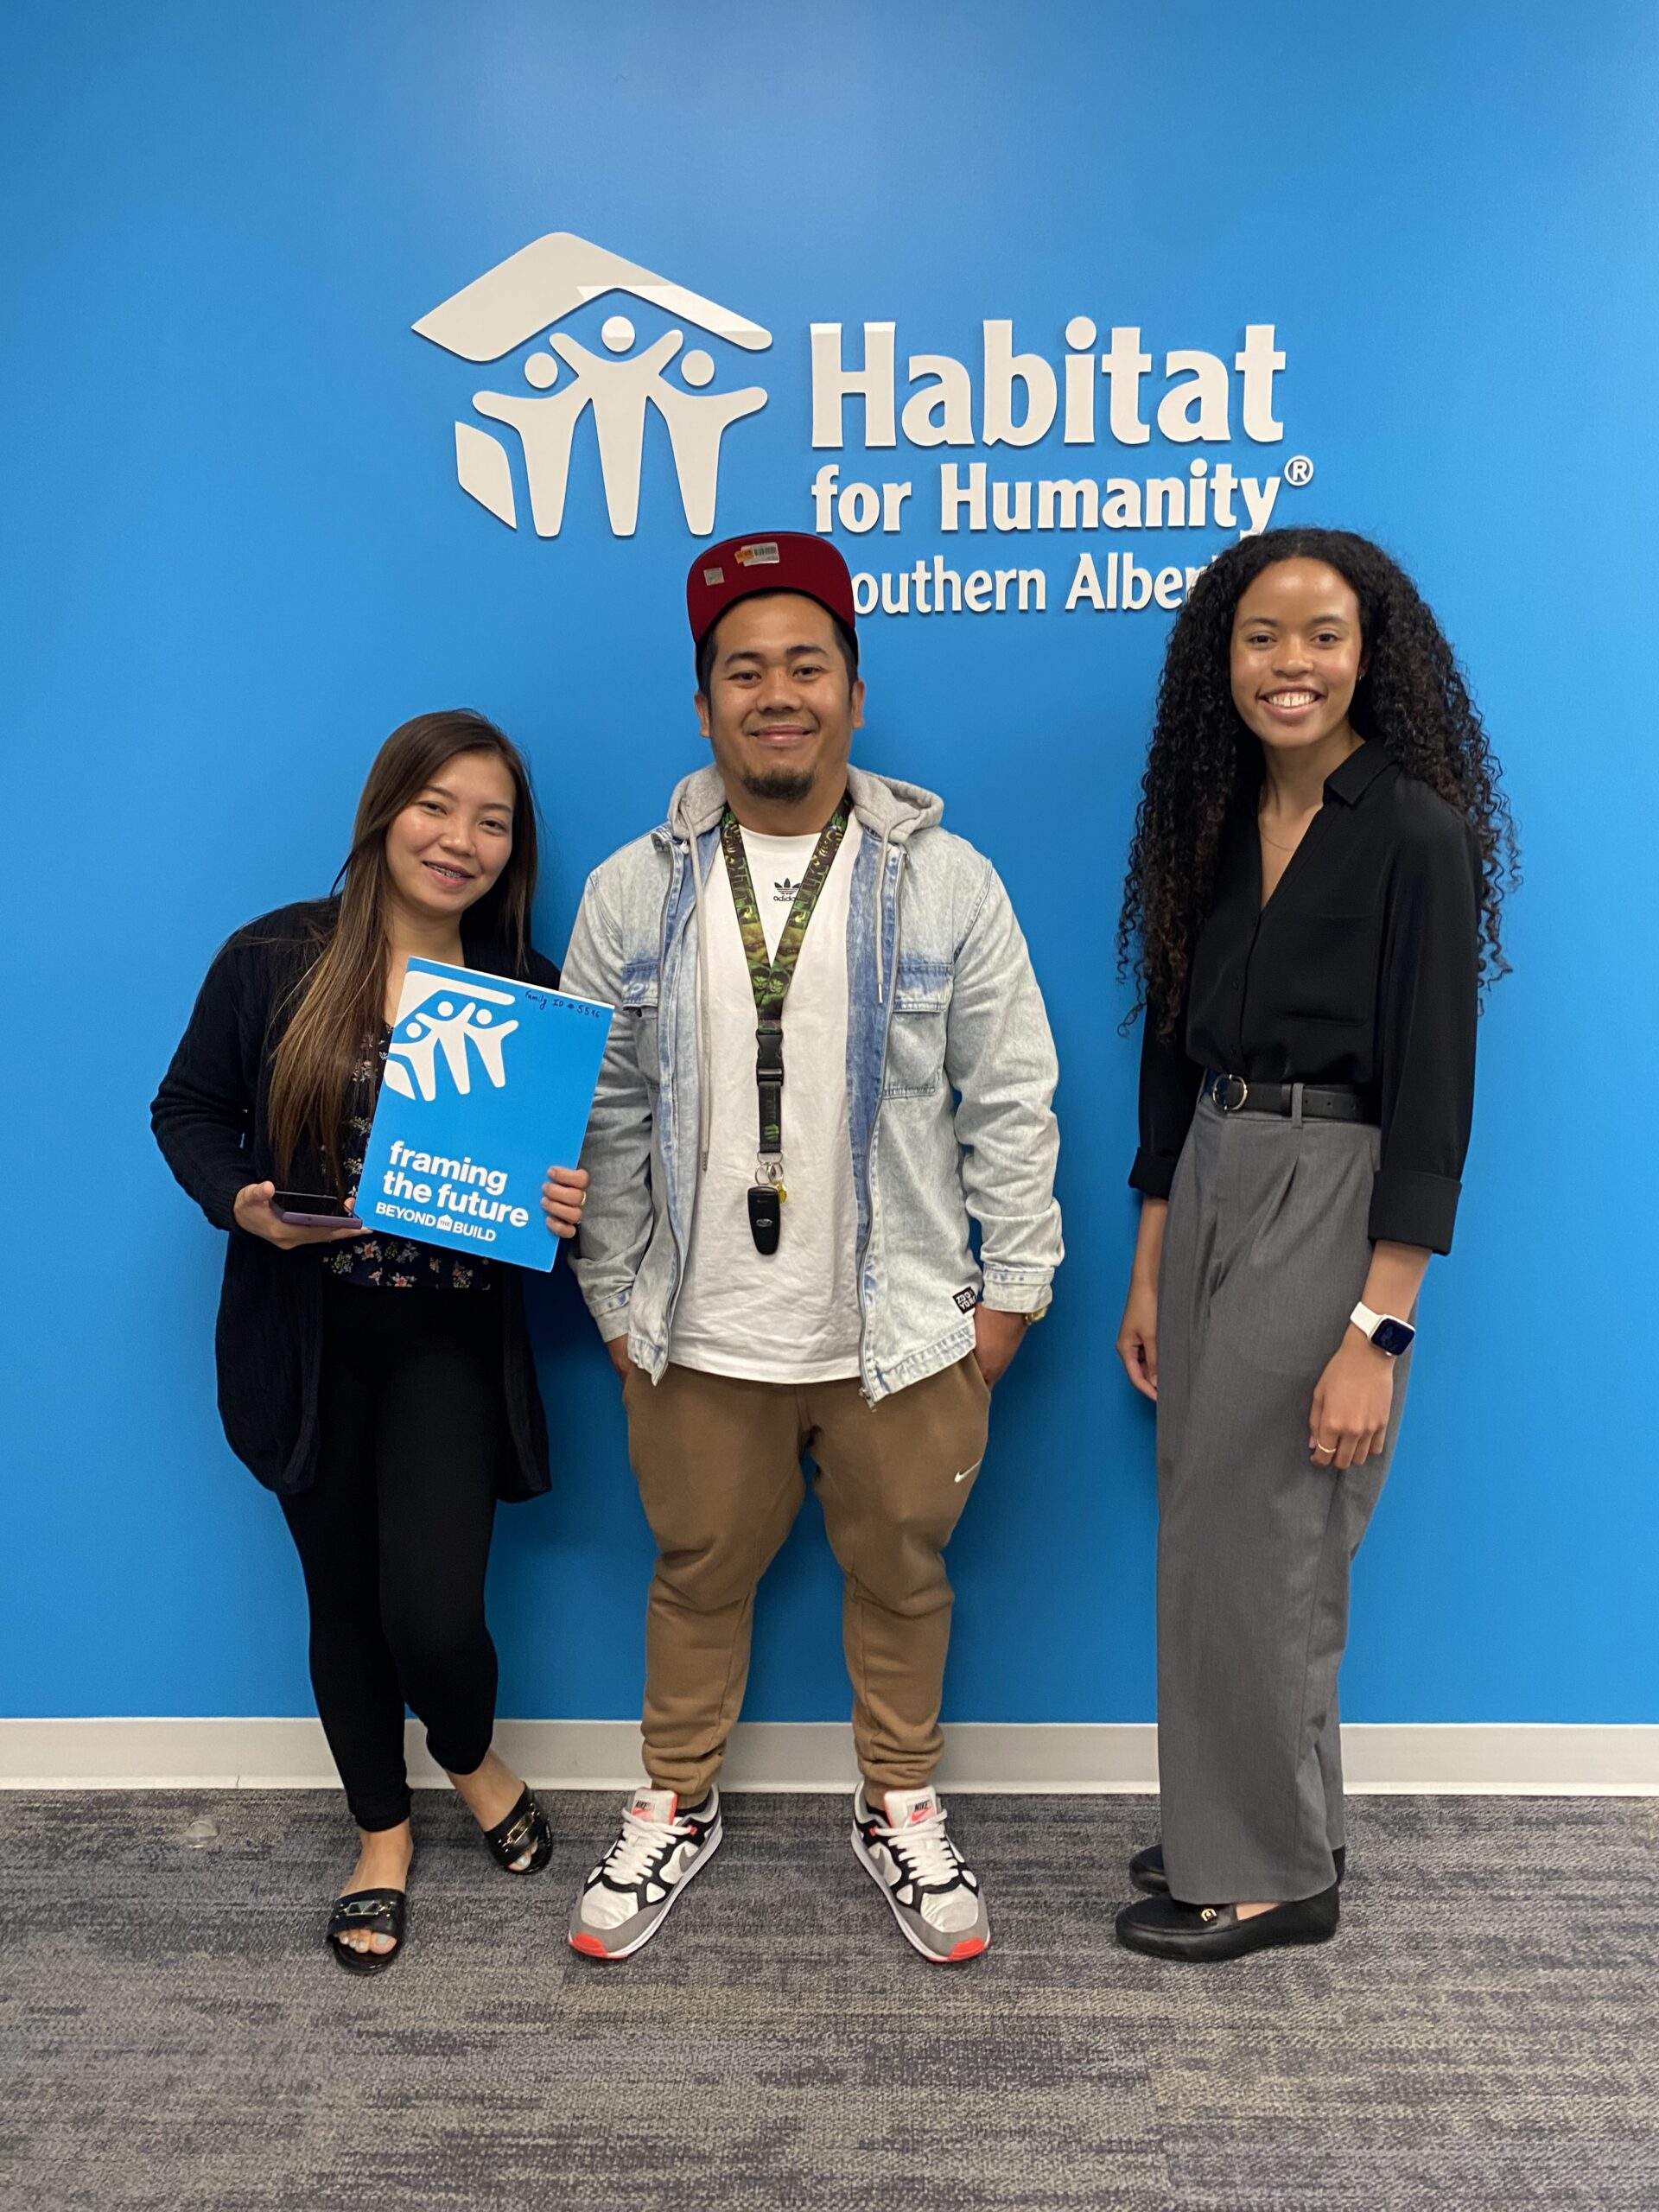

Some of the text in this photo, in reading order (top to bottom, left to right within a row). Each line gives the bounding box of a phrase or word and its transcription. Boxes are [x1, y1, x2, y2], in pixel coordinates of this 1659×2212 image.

[810, 316, 1287, 448] Habitat
[810, 464, 912, 534] for
[853, 555, 1046, 616] outhern
[524, 990, 547, 1010] Family
[390, 1141, 508, 1196] framing
[375, 1202, 436, 1227] BEYOND
[452, 1221, 497, 1243] BUILD
[383, 1170, 529, 1228] the future
[956, 1291, 971, 1305] ZOO
